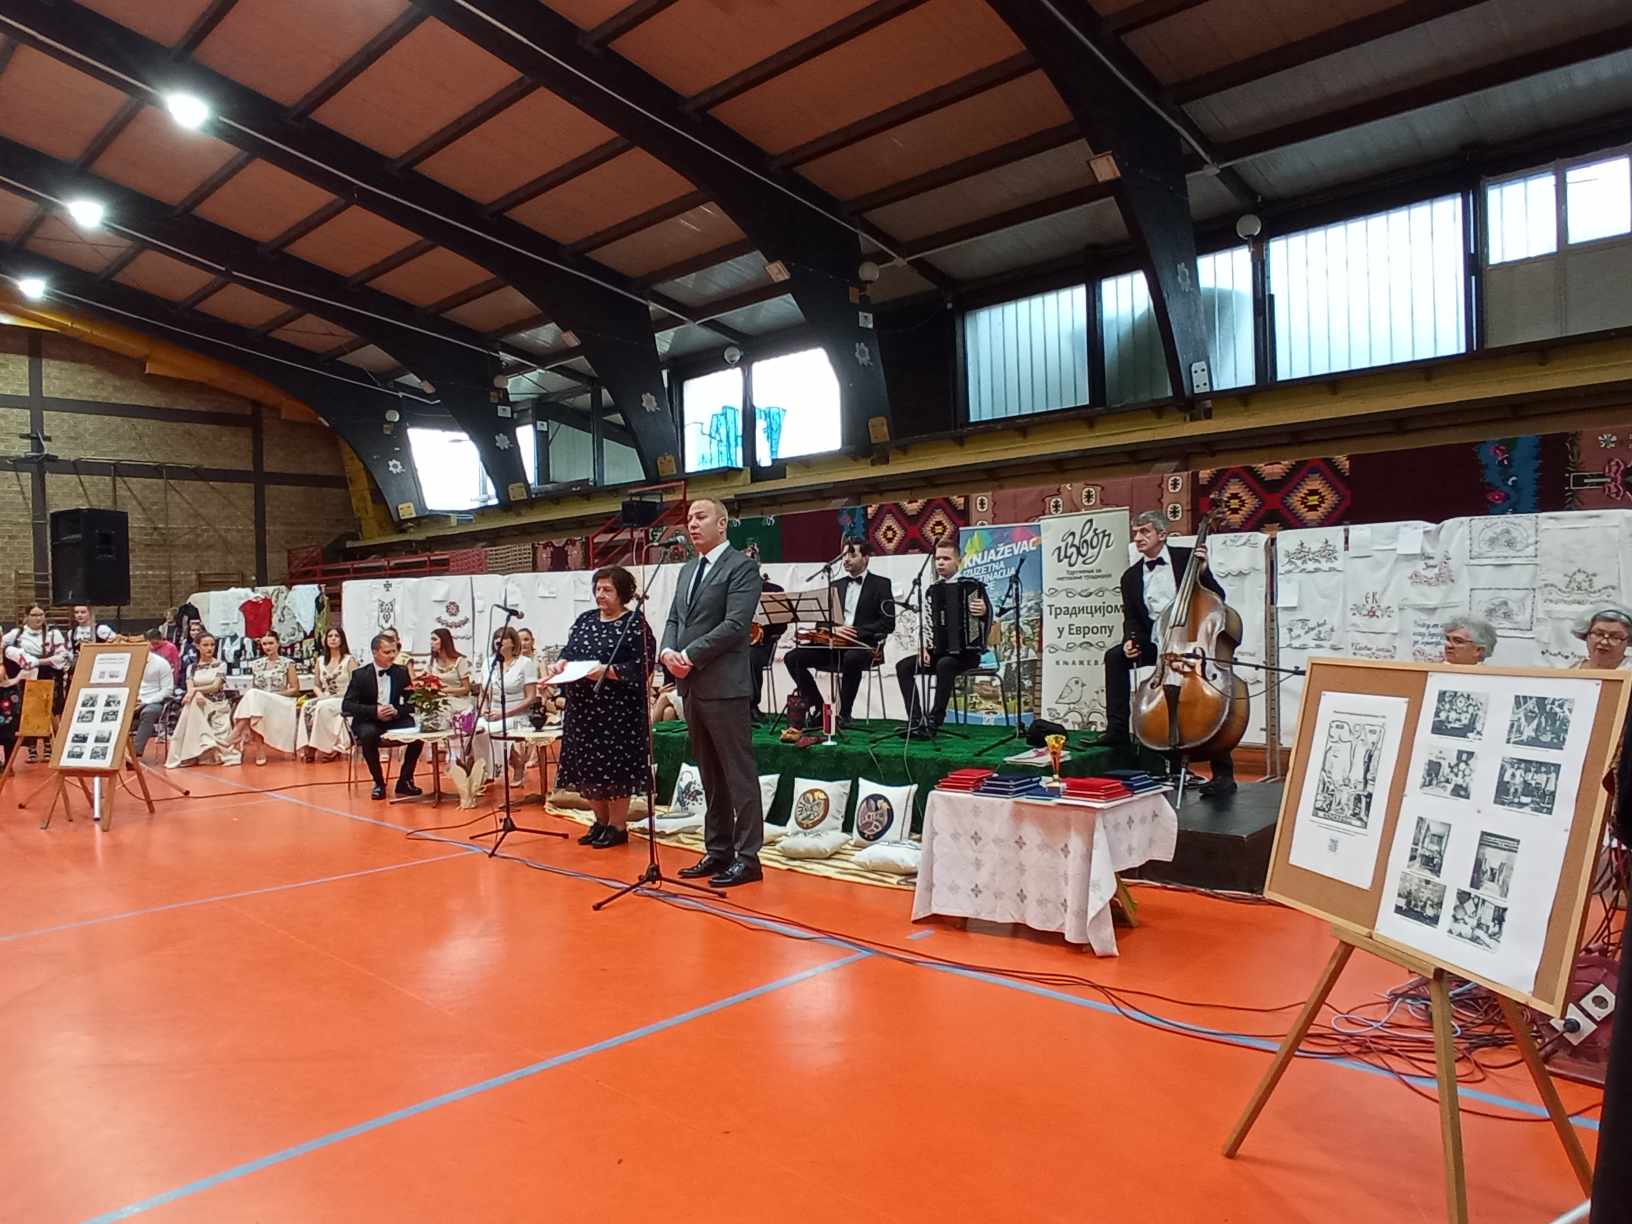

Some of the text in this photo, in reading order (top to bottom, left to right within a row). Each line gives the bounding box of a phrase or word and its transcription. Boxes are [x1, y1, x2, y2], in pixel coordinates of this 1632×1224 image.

[964, 537, 1040, 569] KNJAŽEVAC
[1047, 601, 1121, 619] Традицијом
[1057, 623, 1114, 639] у Европу
